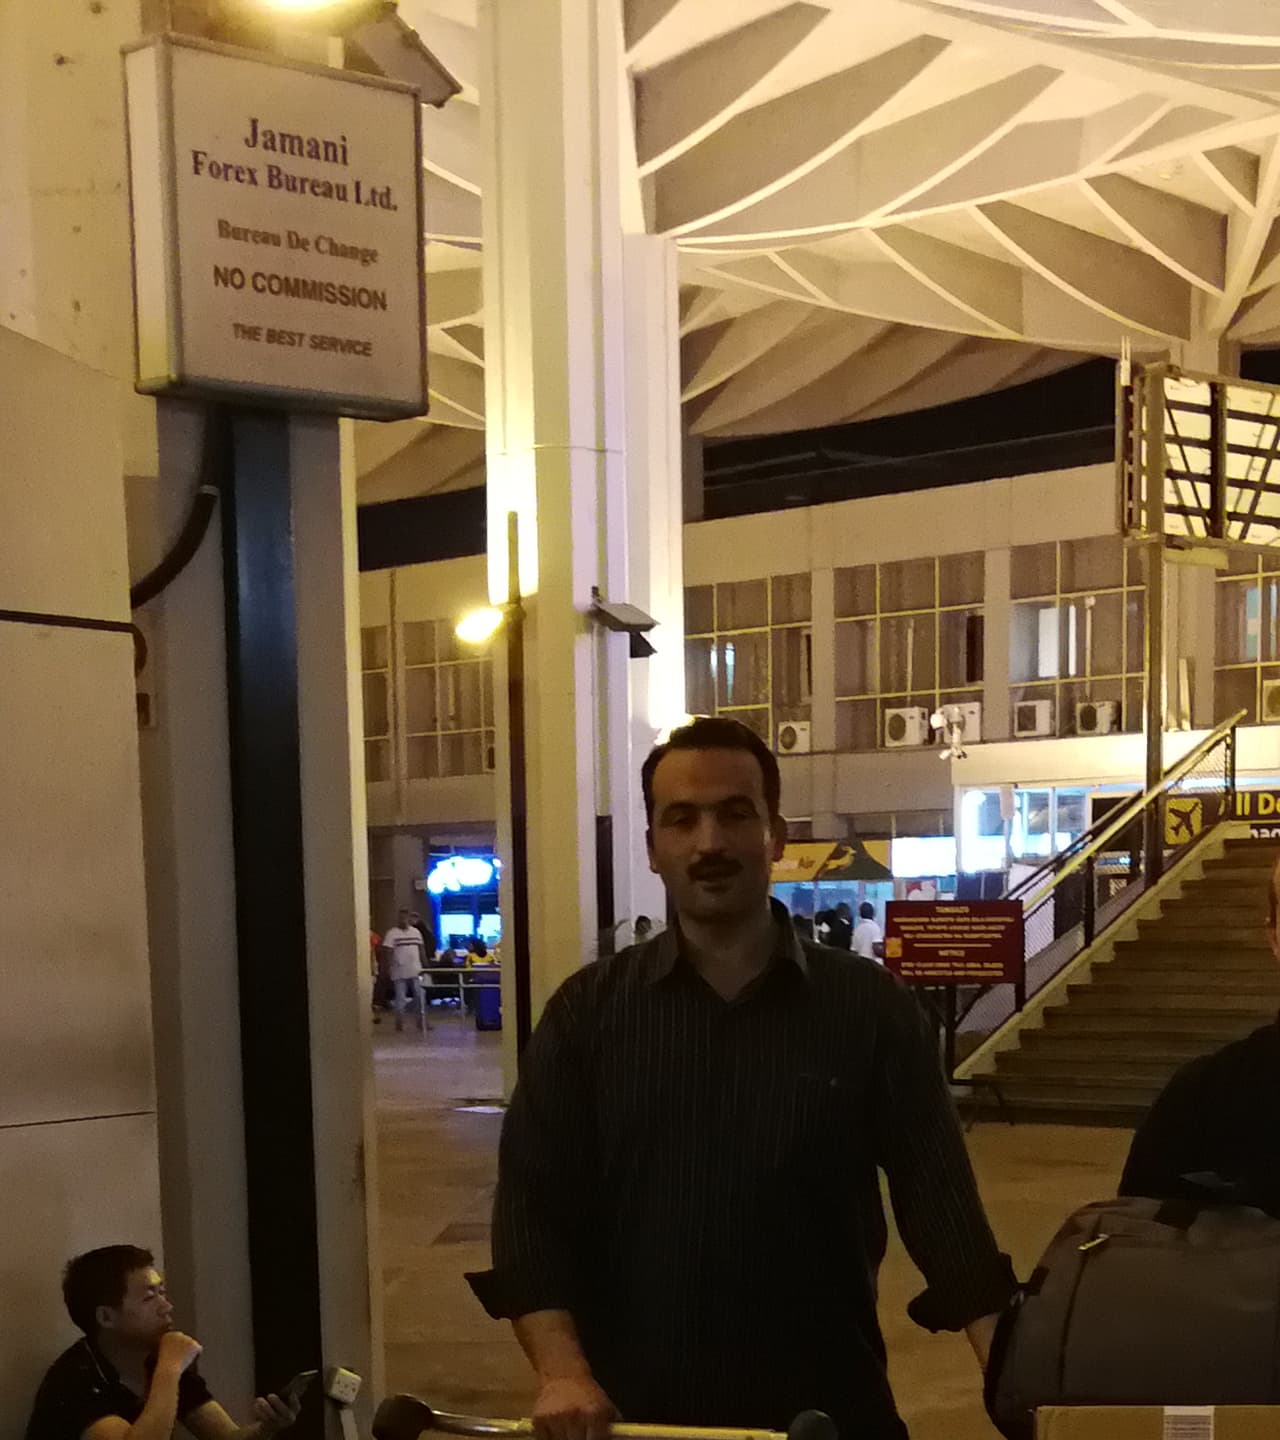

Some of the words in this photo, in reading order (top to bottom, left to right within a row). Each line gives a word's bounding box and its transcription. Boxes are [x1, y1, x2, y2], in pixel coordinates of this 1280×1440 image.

[244, 117, 349, 166] Jamani
[191, 149, 258, 187] Forex
[267, 165, 348, 203] Bureau
[354, 180, 399, 212] Ltd.
[217, 219, 282, 248] Bureau
[287, 230, 310, 253] De
[315, 235, 379, 267] Change
[212, 265, 246, 290] NO
[252, 271, 388, 311] COMMISSION
[233, 323, 261, 343] THE
[266, 328, 305, 348] BEST
[309, 334, 373, 357] SERVICE
